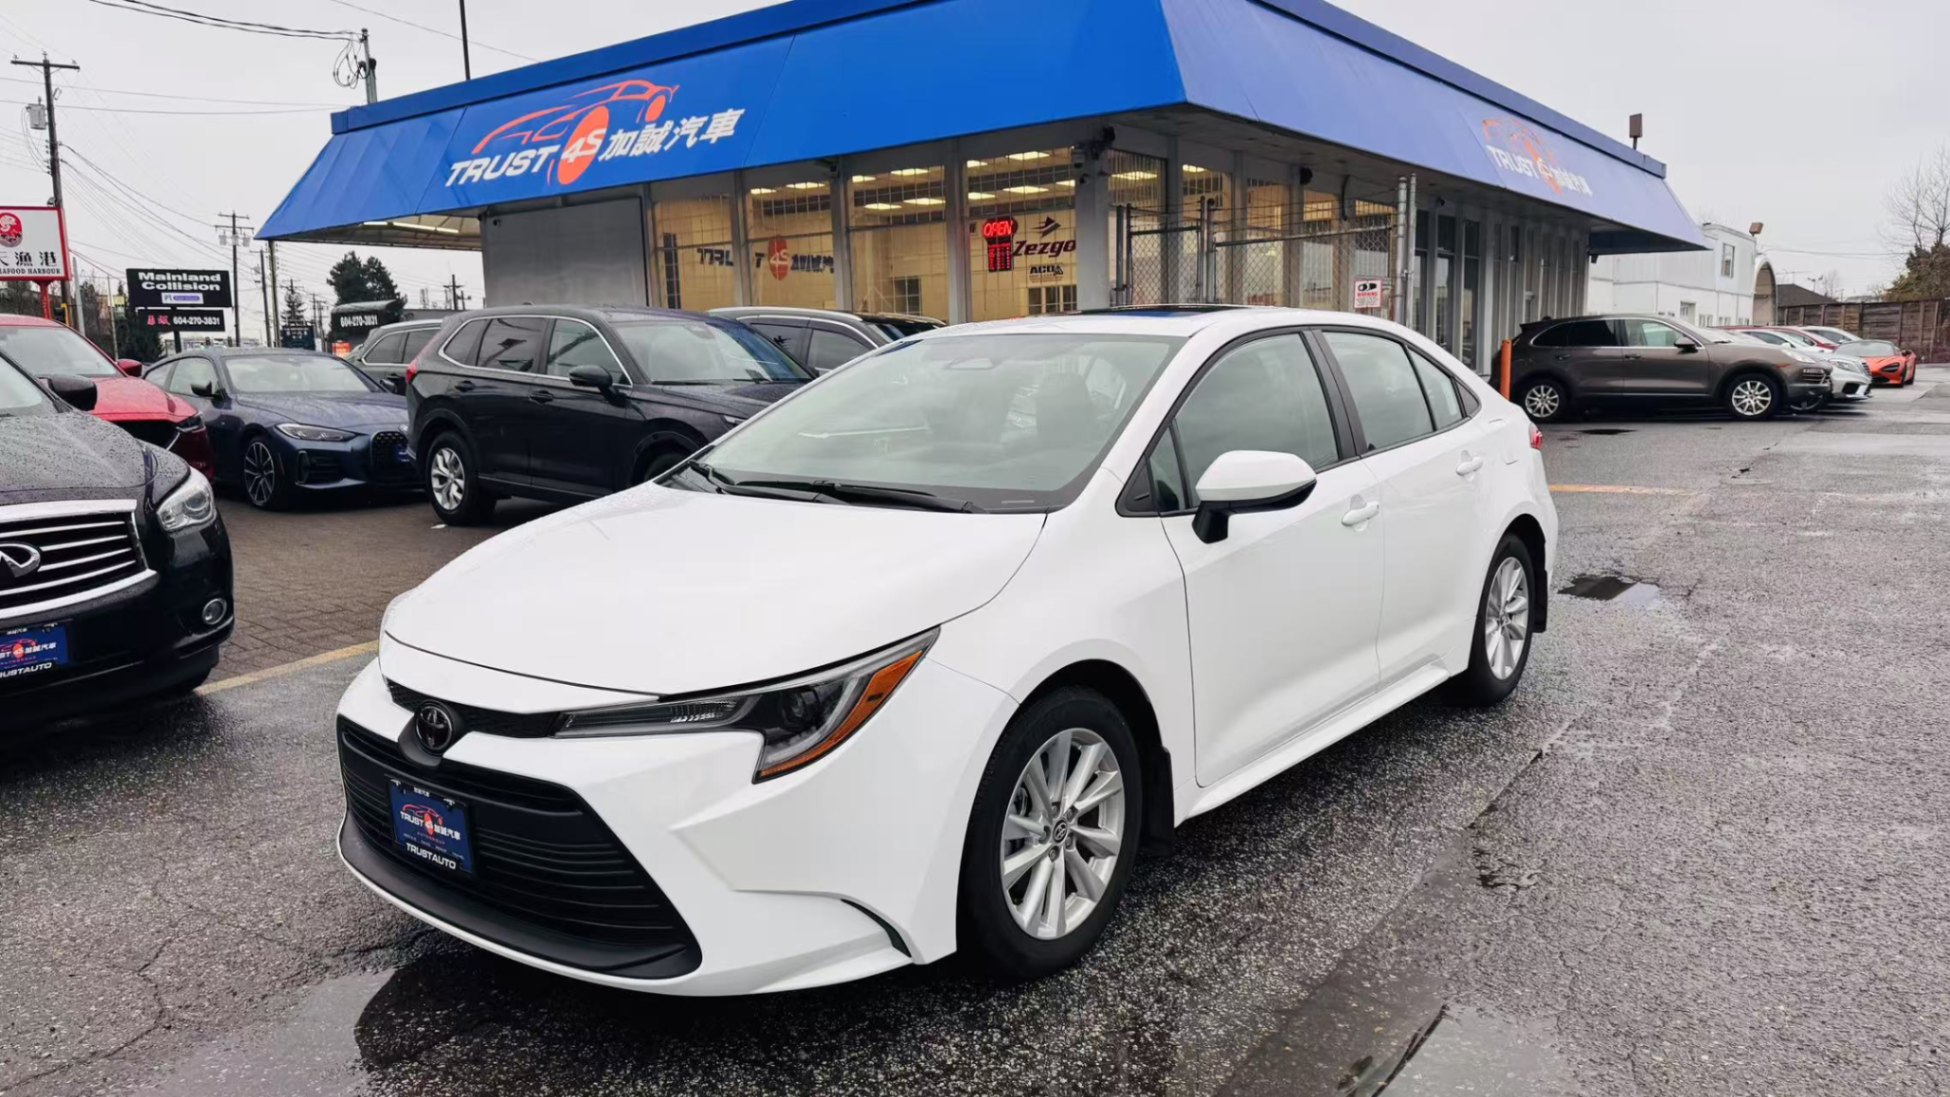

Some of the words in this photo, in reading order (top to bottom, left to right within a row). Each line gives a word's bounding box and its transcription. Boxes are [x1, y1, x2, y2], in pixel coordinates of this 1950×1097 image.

[445, 145, 560, 187] TRUST
[560, 127, 607, 164] 4S
[598, 108, 746, 162] 加誠汽車
[1486, 144, 1539, 180] TRUST
[983, 220, 1014, 237] OPEN
[1012, 239, 1077, 258] Zezgo
[138, 272, 222, 282] Mainland
[141, 281, 221, 291] Collision
[400, 811, 424, 827] TRUST
[406, 842, 457, 870] TRUSTAUTO
